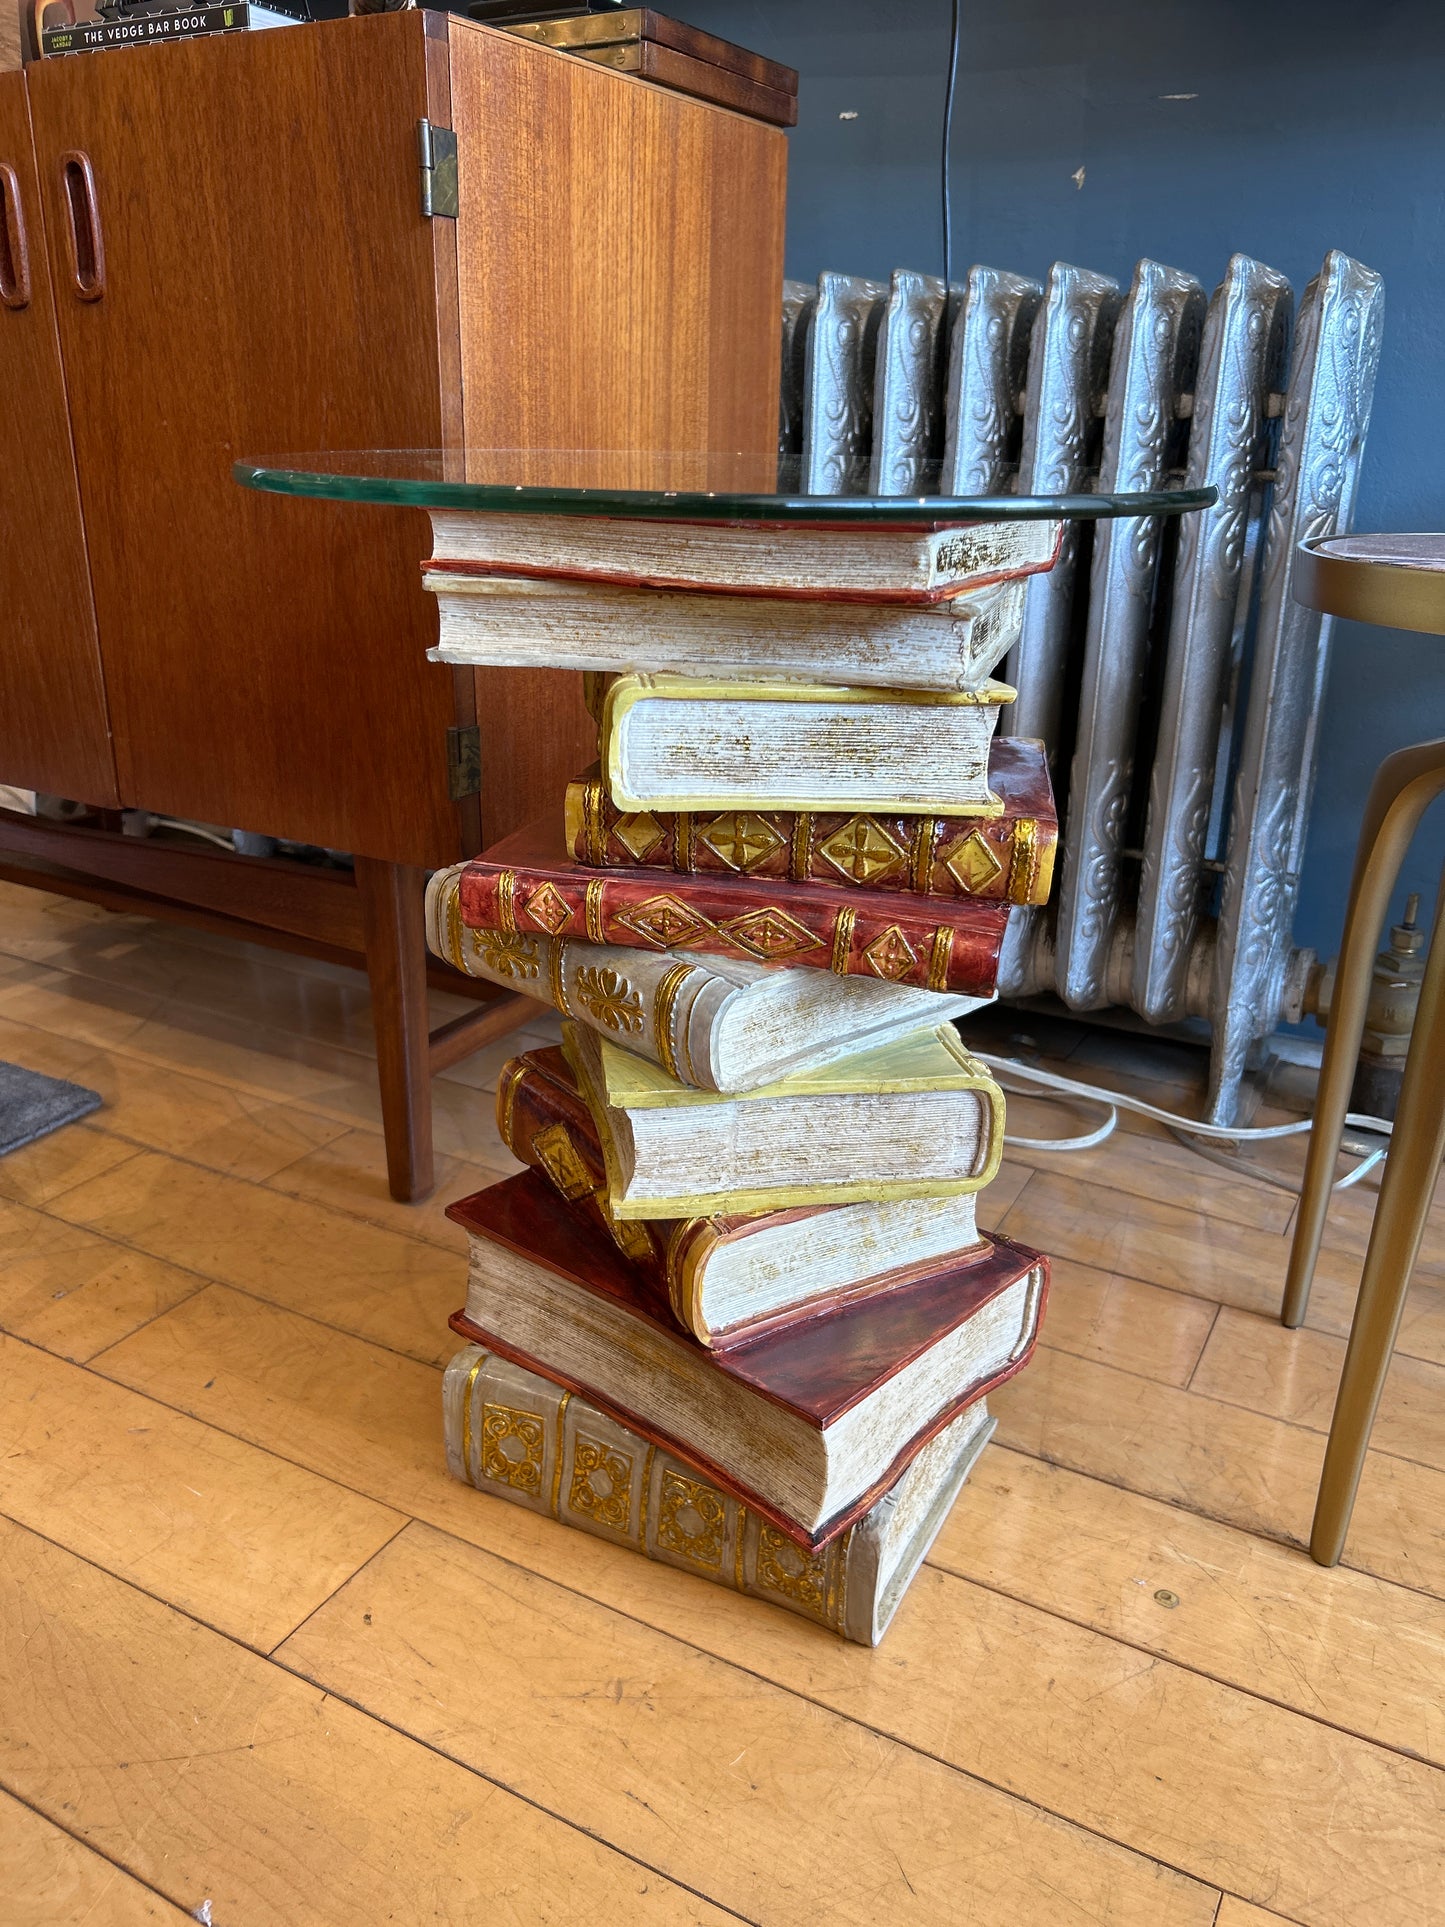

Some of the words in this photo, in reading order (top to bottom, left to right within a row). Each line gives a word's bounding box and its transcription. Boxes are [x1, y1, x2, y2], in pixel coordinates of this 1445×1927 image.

[84, 30, 104, 44] THE
[107, 24, 144, 40] VEDGE
[148, 20, 170, 35] BAR
[174, 15, 207, 31] BOOK
